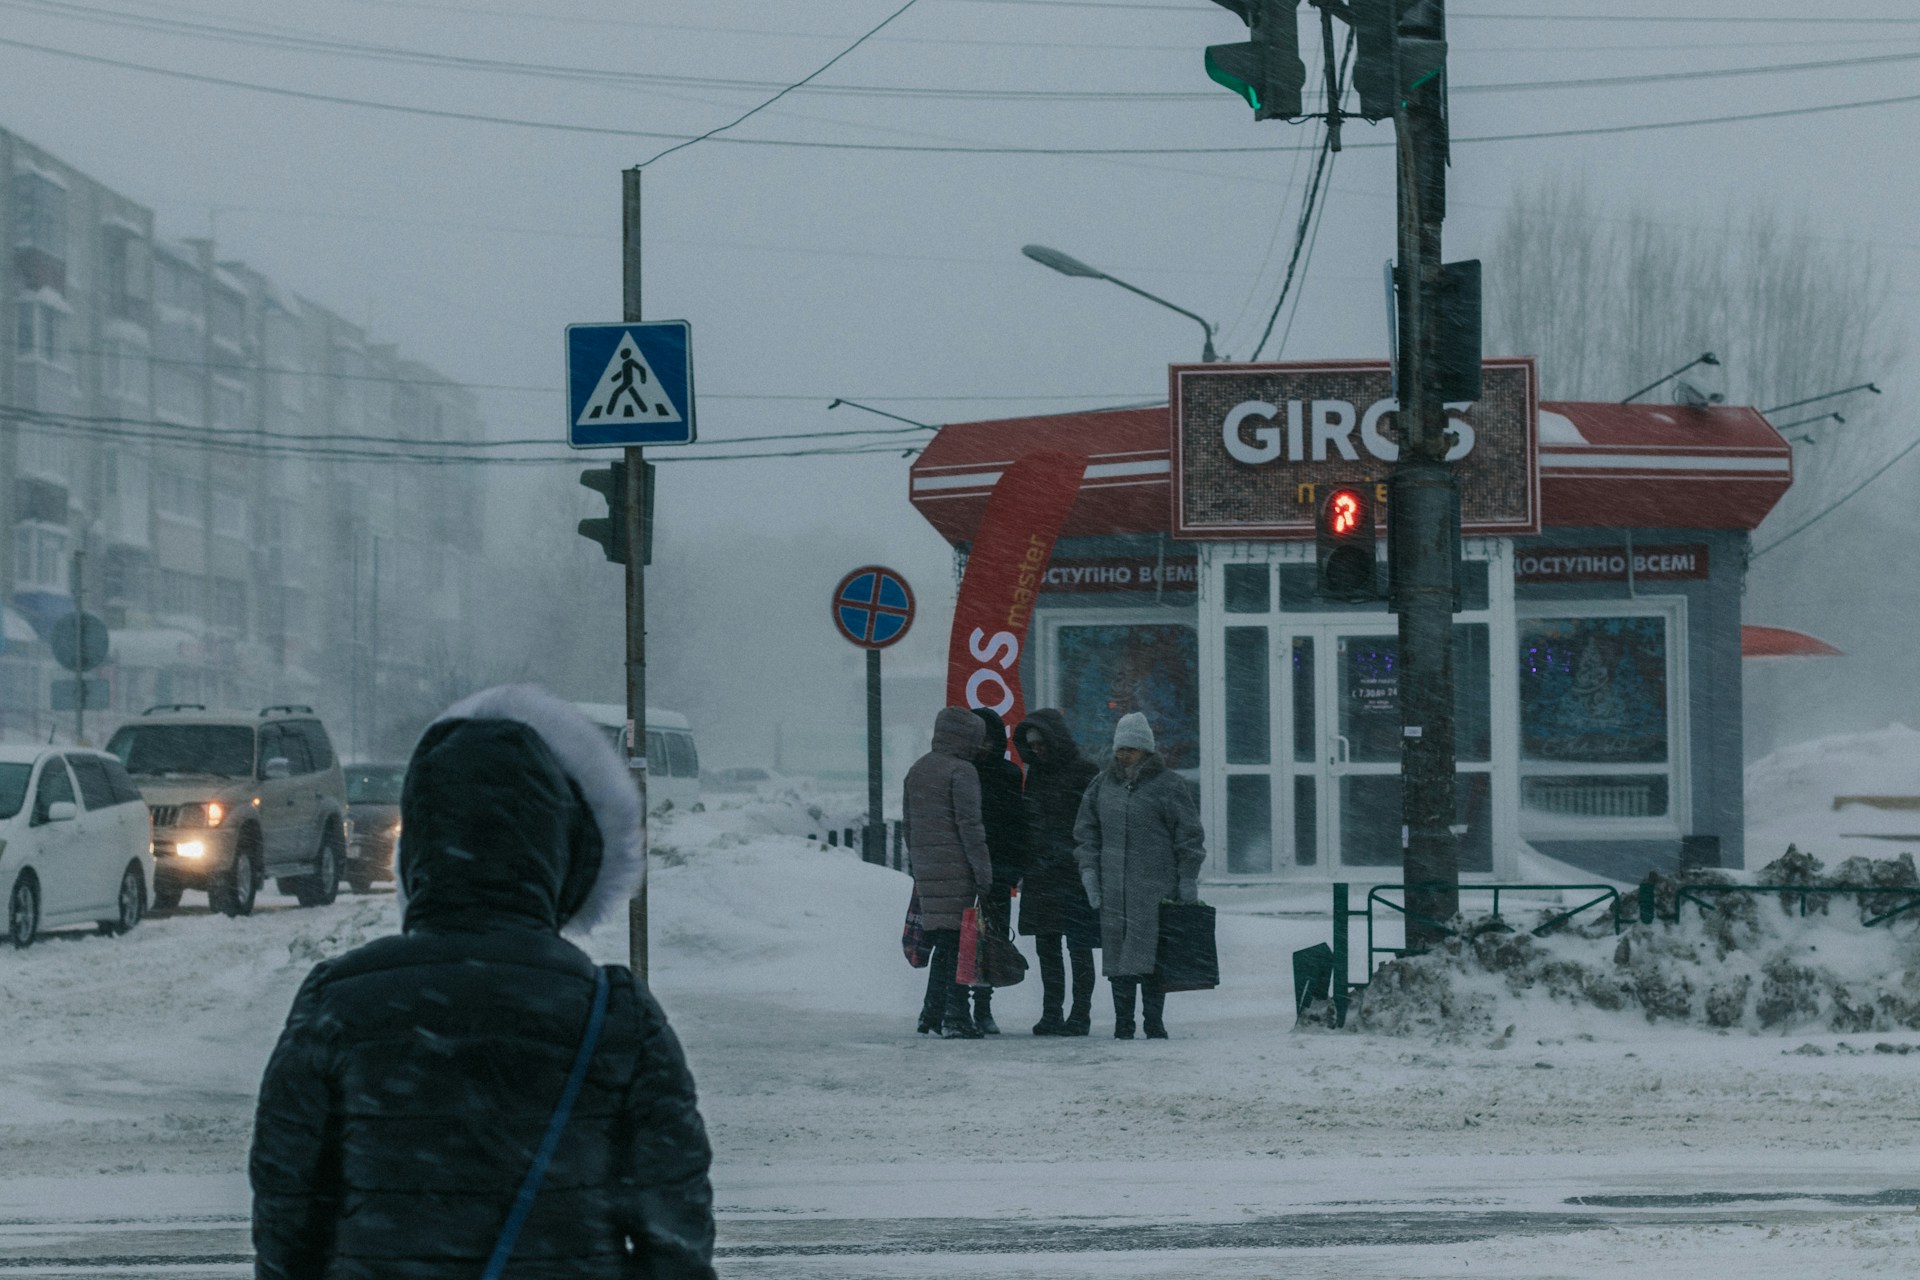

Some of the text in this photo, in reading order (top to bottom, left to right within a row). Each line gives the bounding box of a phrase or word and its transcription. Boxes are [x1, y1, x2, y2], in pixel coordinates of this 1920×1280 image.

[1008, 533, 1047, 629] master
[1041, 565, 1132, 585] СТУПНО
[1634, 553, 1696, 573] ВСЕМ!
[965, 626, 1019, 740] OS
